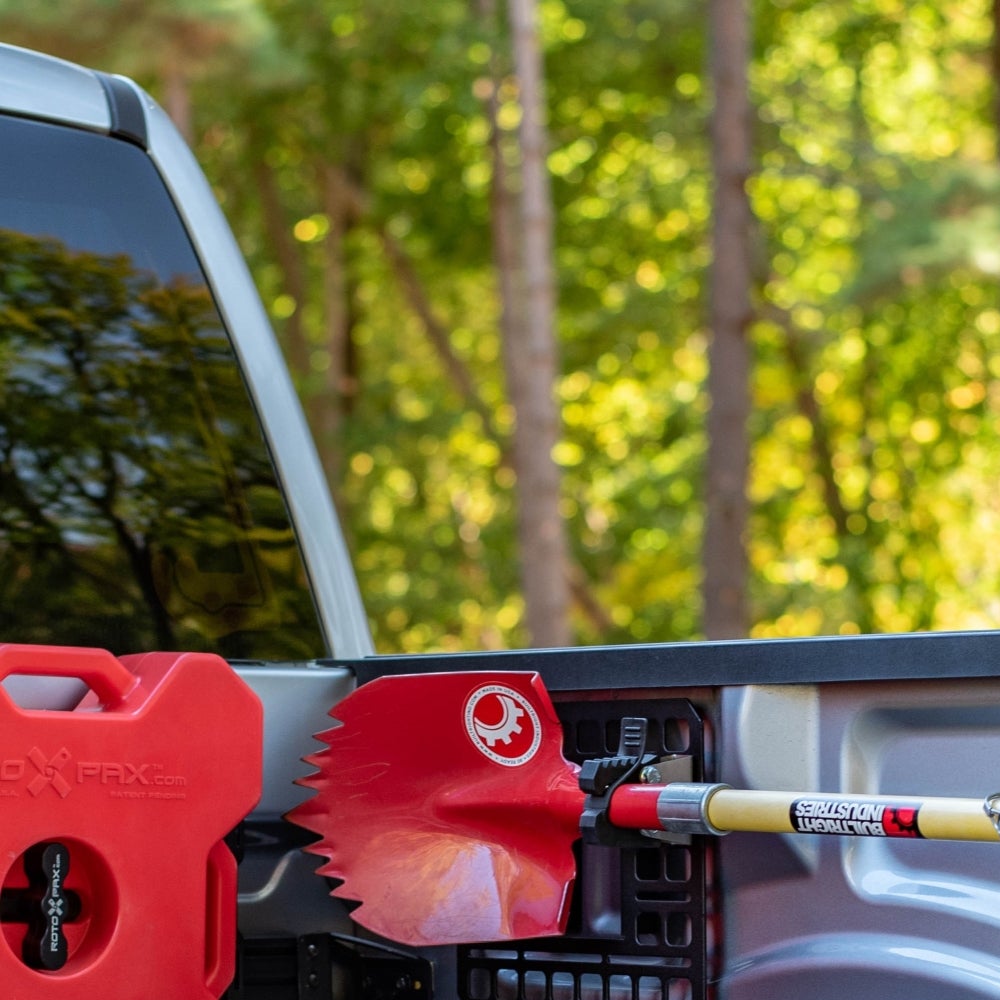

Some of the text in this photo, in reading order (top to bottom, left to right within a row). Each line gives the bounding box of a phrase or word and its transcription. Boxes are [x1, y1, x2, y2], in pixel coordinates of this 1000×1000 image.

[795, 800, 885, 822] INDUSTRIES
[797, 816, 887, 837] BUILTRIGHT
[51, 916, 59, 952] ROTO
